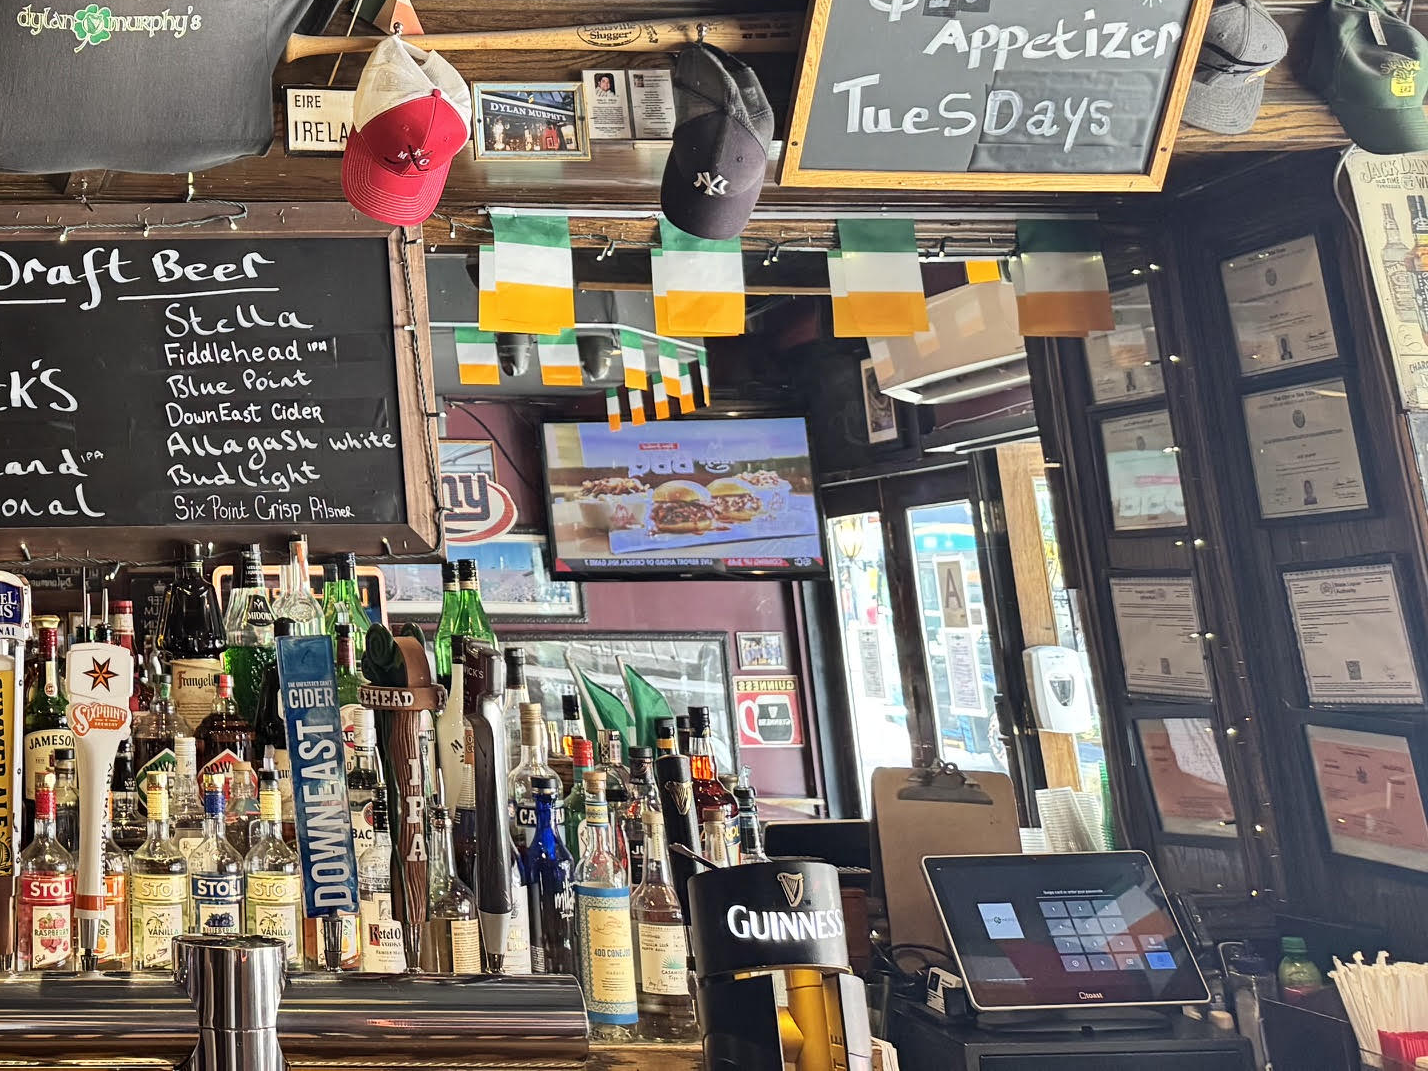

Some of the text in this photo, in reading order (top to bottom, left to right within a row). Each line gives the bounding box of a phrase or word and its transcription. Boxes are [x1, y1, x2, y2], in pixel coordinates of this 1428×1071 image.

[17, 4, 75, 35] dylan
[589, 30, 632, 41] Slugger
[922, 9, 1182, 71] Appetizer
[293, 94, 322, 109] EIRE
[489, 102, 568, 123] DYLAN MURPHY'S
[293, 121, 348, 143] IRELA
[150, 248, 276, 283] Beer
[164, 302, 315, 339] Stella
[163, 338, 303, 367] Fiddlehead
[165, 367, 313, 400] Blue Point
[164, 401, 262, 428] DownEast
[80, 448, 105, 464] IPA
[165, 428, 398, 471] Allagash white
[165, 460, 236, 487] Bud
[174, 495, 206, 521] Six
[206, 495, 250, 520] Point
[253, 494, 302, 523] Crisp
[943, 565, 966, 611] A
[288, 688, 335, 709] CIDER
[72, 701, 129, 736] SIXPOINT
[298, 719, 347, 908] DOWNEAST
[405, 757, 428, 862] IPA
[30, 881, 73, 897] STOLI
[197, 881, 241, 897] STOLI
[34, 928, 70, 937] RASPBERRY
[148, 927, 181, 936] VANILLA
[260, 928, 293, 936] VANILLA
[368, 923, 394, 946] Ketel
[726, 903, 845, 941] GUINNESS
[594, 948, 607, 958] 400
[1084, 991, 1104, 1000] toast
